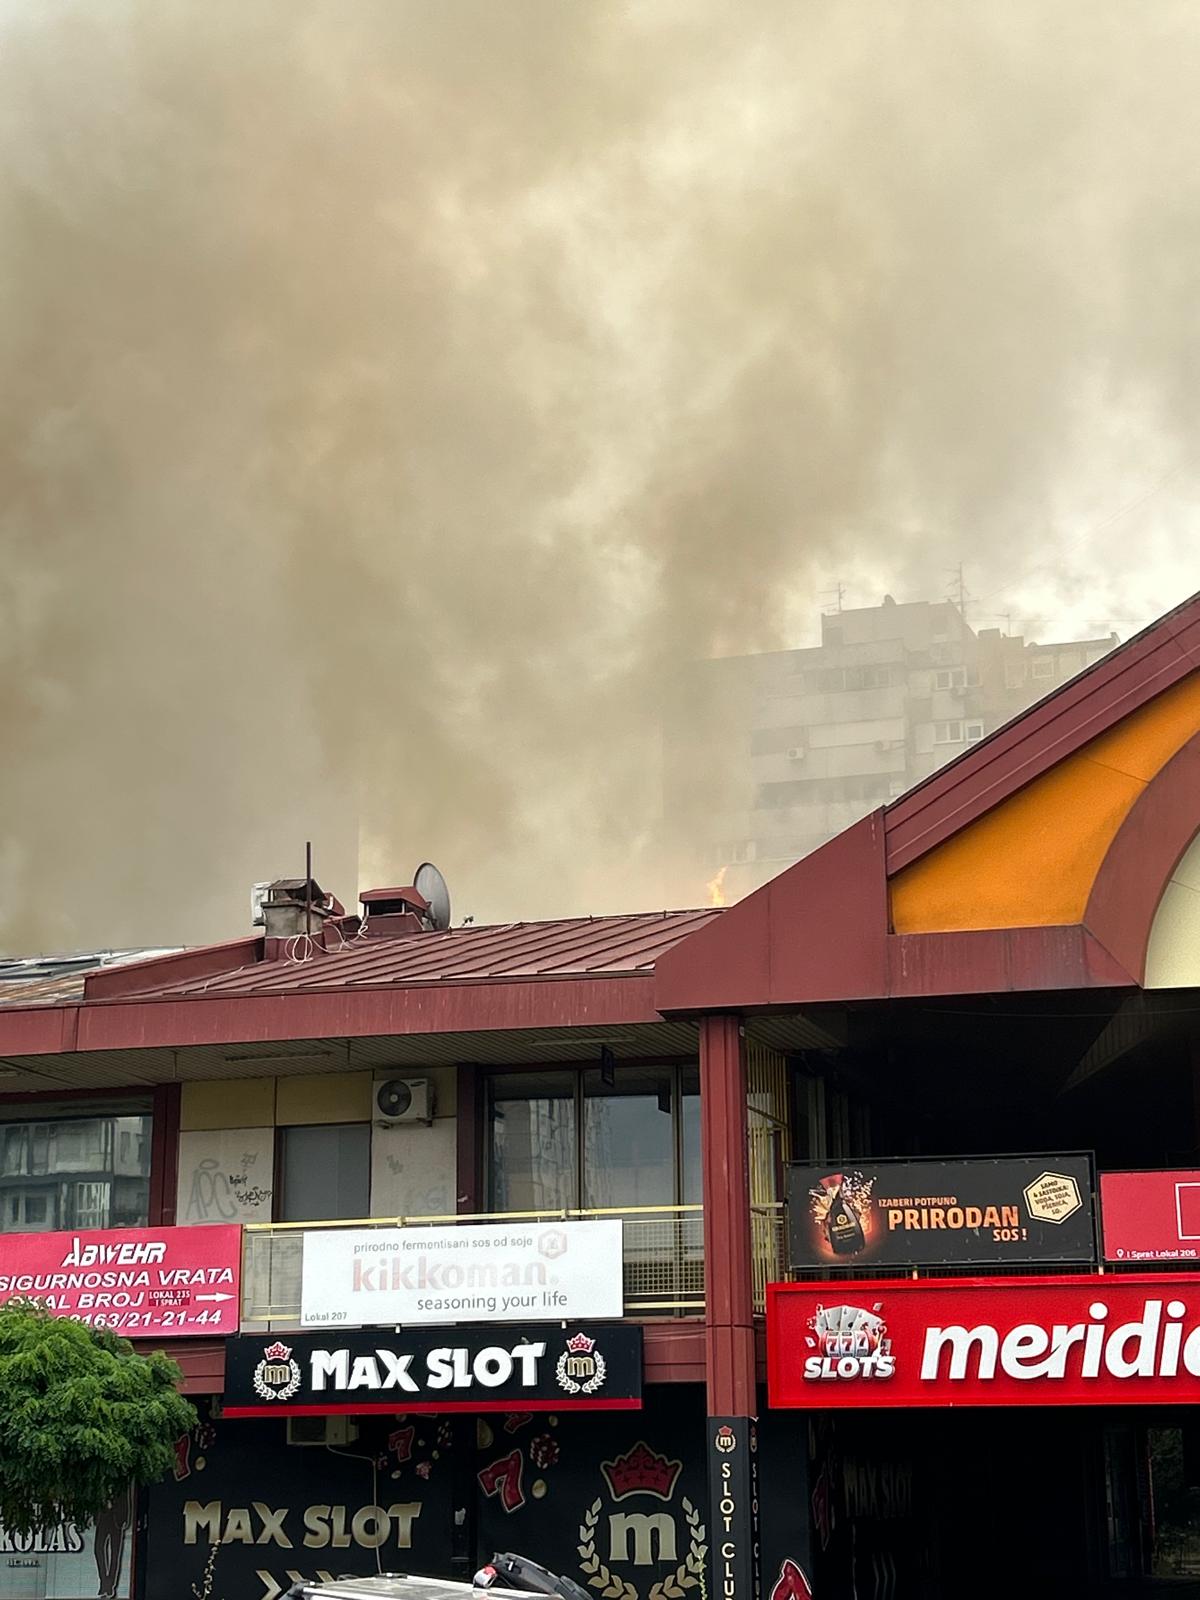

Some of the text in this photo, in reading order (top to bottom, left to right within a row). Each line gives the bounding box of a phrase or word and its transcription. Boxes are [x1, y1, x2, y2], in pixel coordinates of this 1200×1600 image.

[878, 1196, 957, 1208] IZABERI POTPUNO
[888, 1206, 1019, 1231] PRIRODAN
[61, 1237, 167, 1267] ABWEHR
[353, 1241, 400, 1255] prirodno
[402, 1239, 469, 1251] fermentisani
[472, 1239, 491, 1248] sos
[493, 1236, 508, 1247] od
[1131, 1250, 1154, 1259] Sprat
[1180, 1249, 1197, 1257] 206
[0, 1268, 234, 1292] SIGURNOSNA VRATA
[77, 1291, 145, 1309] BROJ
[149, 1290, 191, 1299] LOKAL 235
[161, 1298, 182, 1306] SPRAT
[417, 1291, 568, 1312] seasoning your life
[304, 1311, 348, 1322] Lokal 207
[310, 1349, 420, 1392] MAX
[426, 1342, 547, 1389] SLOT
[803, 1355, 896, 1379] SLOTS
[719, 1462, 735, 1533] SLOT
[182, 1500, 424, 1550] MAX SLOT
[721, 1542, 737, 1600] CLU
